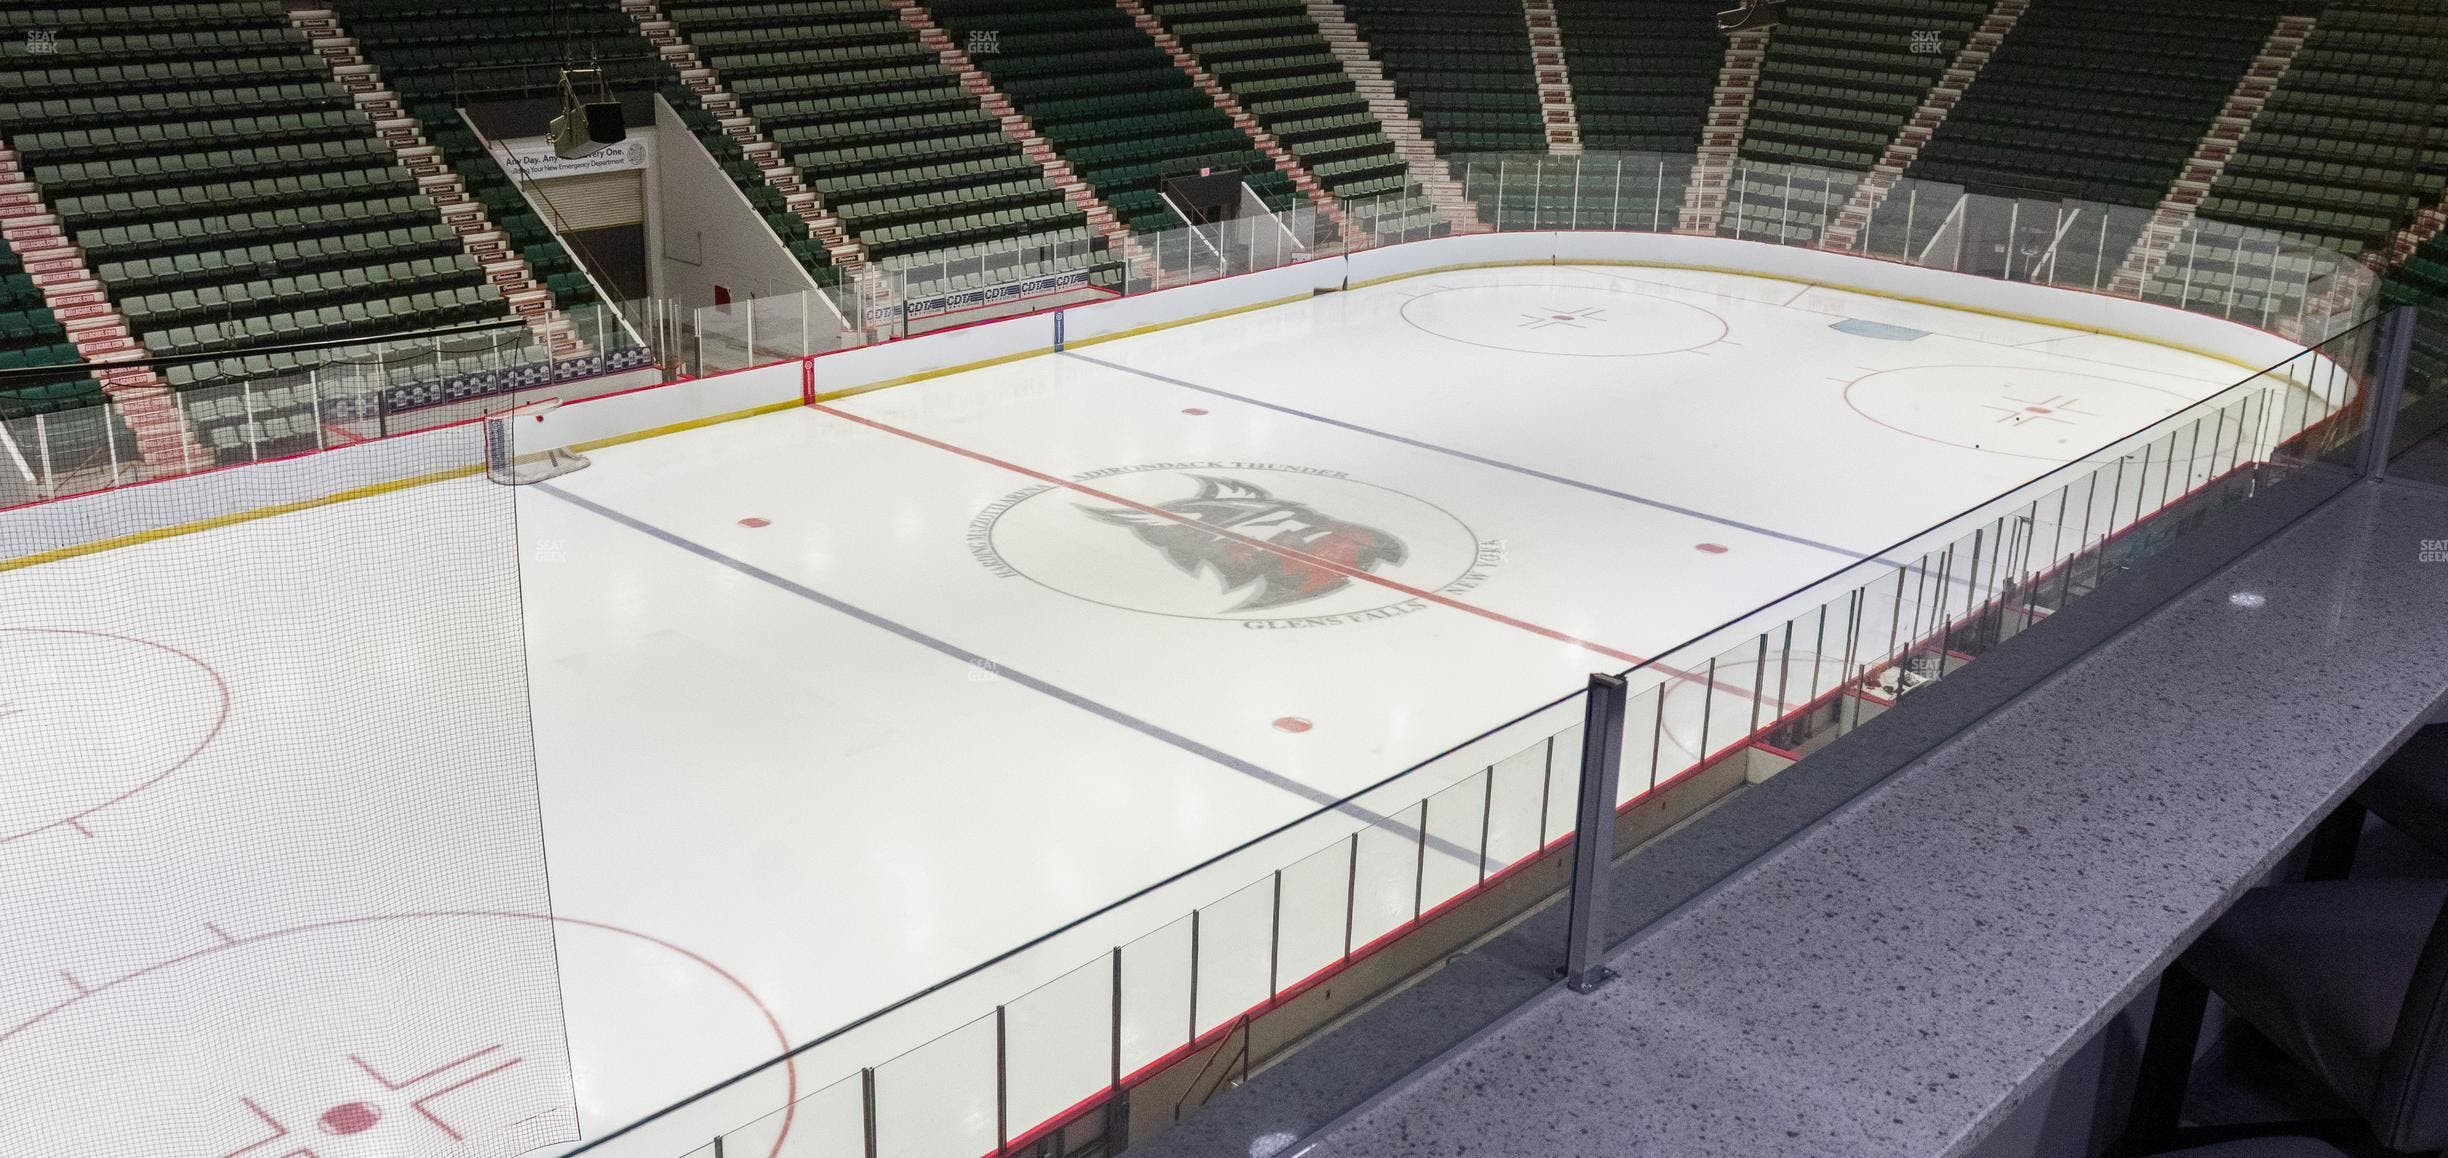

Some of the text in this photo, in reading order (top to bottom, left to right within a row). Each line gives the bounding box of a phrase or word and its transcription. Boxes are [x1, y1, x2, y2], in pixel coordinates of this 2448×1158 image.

[523, 156, 541, 164] Day.
[606, 147, 625, 156] One.
[531, 165, 545, 174] Your
[559, 161, 591, 171] Emergency
[591, 158, 625, 168] Department
[1021, 280, 1046, 293] CDTA
[1056, 273, 1079, 287] CDTA
[947, 293, 972, 306] CDTA
[985, 287, 1010, 300] CDTA
[908, 301, 933, 314] CDTA
[1072, 461, 1349, 480] ADIRONDACK THUNDER
[1446, 570, 1489, 596] NEW
[1242, 600, 1427, 630] GLENS FALLS
